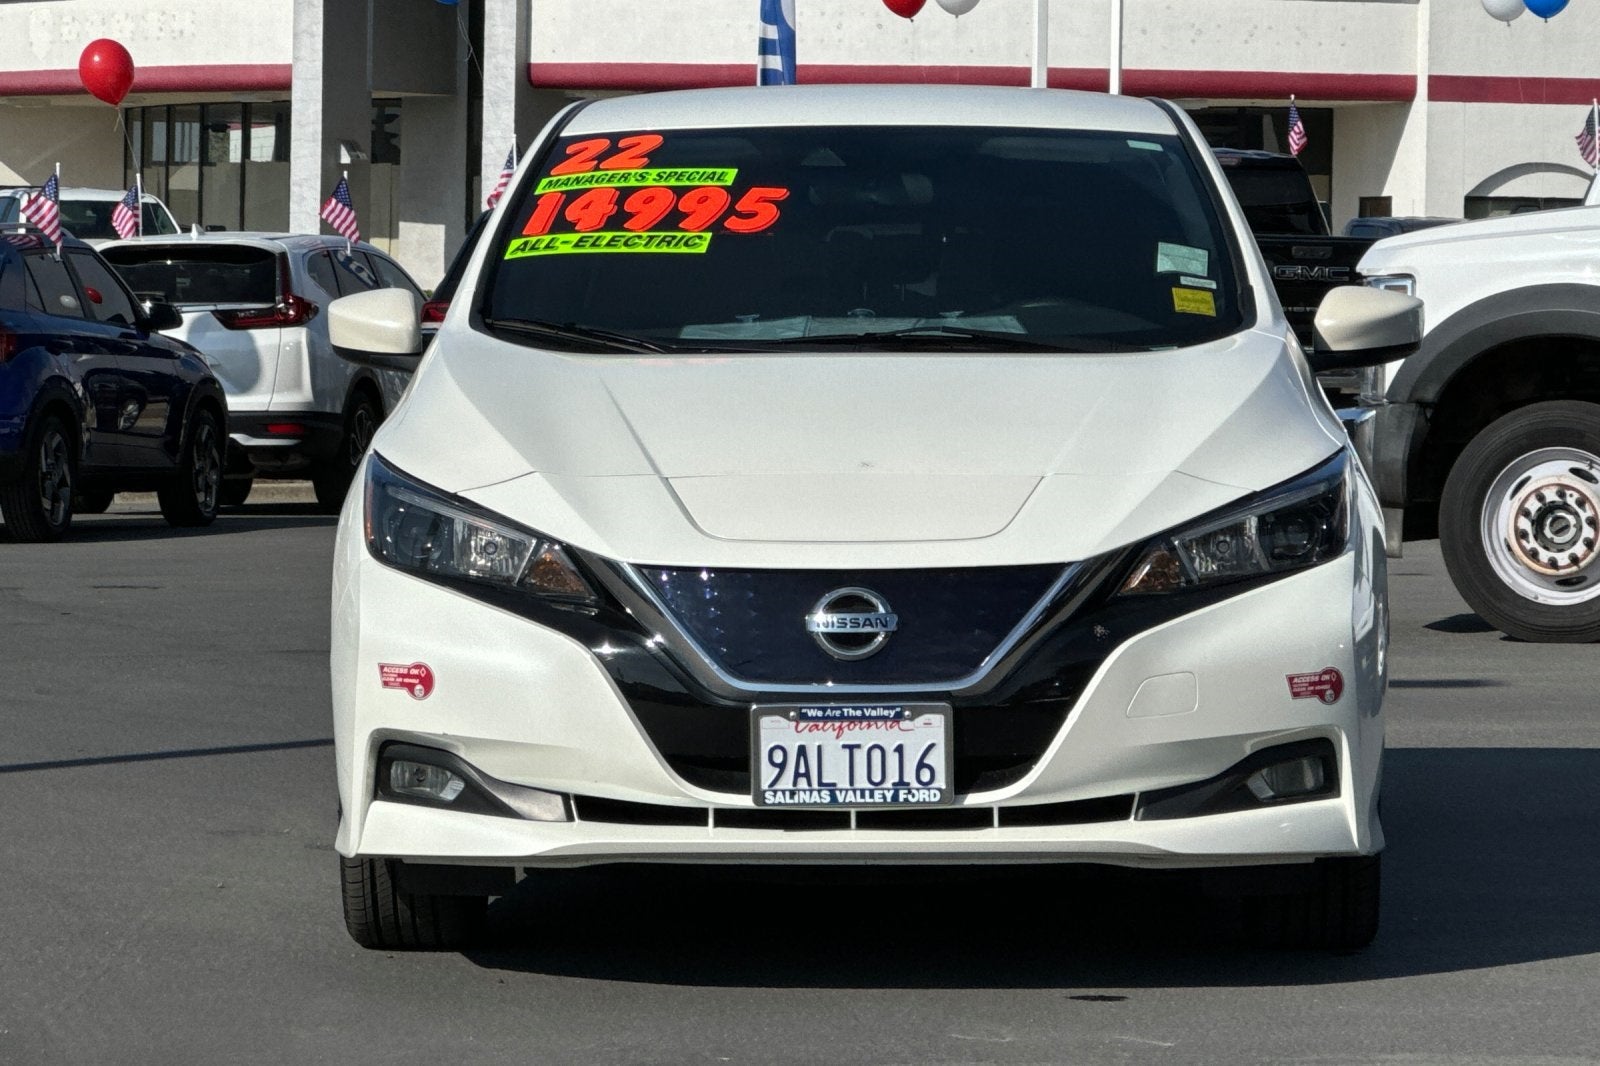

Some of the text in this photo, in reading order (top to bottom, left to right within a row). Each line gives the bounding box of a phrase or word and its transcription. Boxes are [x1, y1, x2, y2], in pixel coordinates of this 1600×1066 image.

[550, 134, 665, 175] 22
[541, 169, 729, 190] MANAGER'S SPECIAL
[522, 186, 790, 235] 14995
[510, 234, 707, 255] ALL-ELECTRIC
[1274, 265, 1350, 282] GMC
[816, 617, 889, 629] NISSAN
[825, 708, 841, 717] Are
[842, 708, 863, 717] The
[767, 742, 937, 788] 9ALT016
[764, 789, 941, 804] SALINAS VALLEY FORD
